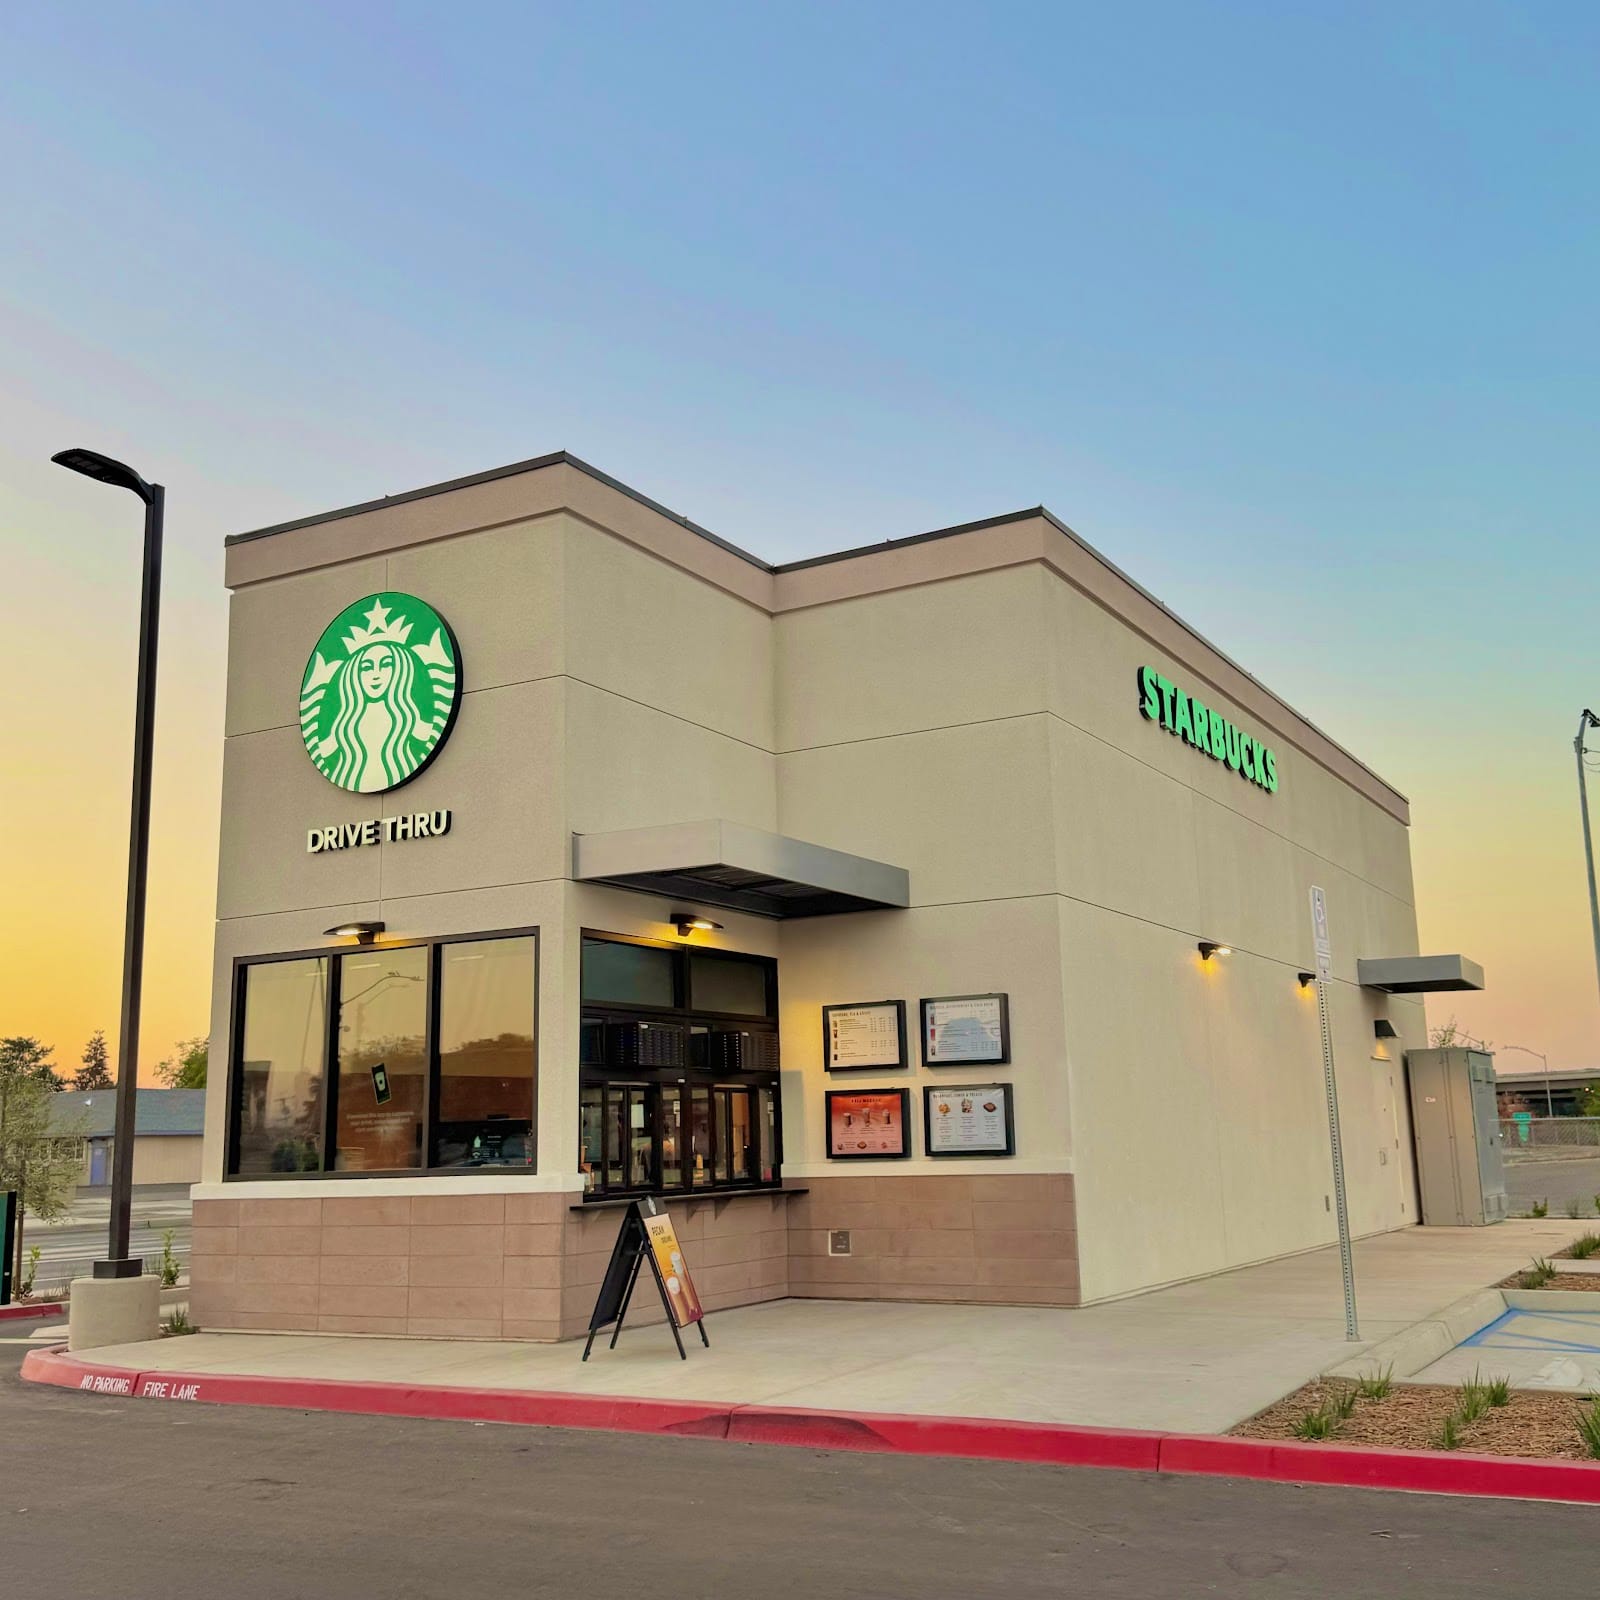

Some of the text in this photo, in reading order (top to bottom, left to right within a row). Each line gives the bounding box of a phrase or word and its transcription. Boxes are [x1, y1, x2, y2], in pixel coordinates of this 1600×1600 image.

[1137, 665, 1279, 793] STARBUCKS
[307, 809, 451, 853] DRIVE THRU
[80, 1375, 200, 1400] NO PARKING FIRE LANE
